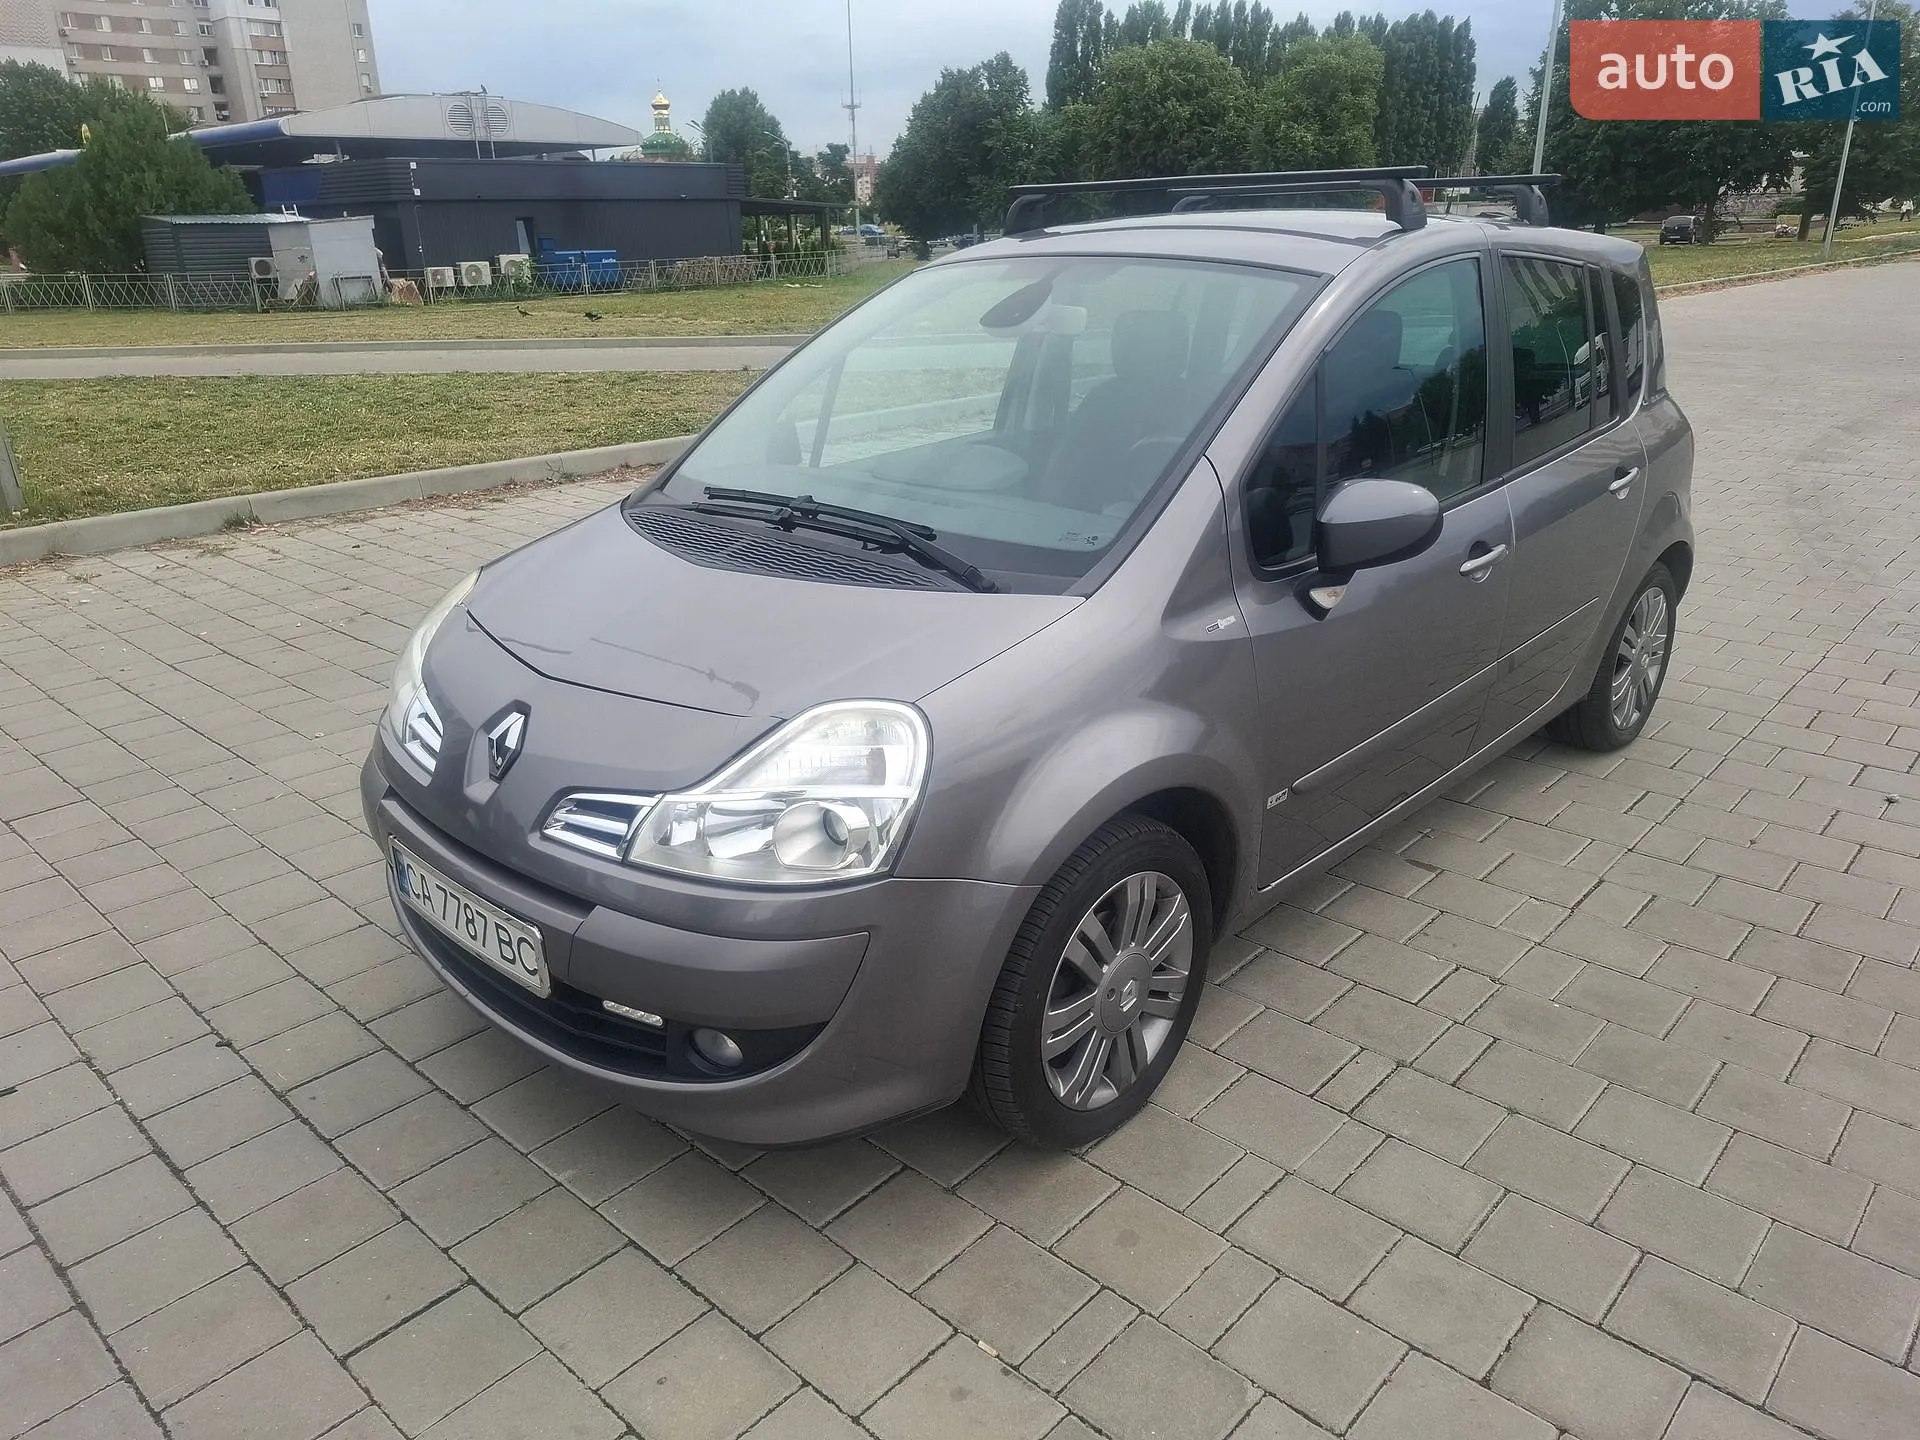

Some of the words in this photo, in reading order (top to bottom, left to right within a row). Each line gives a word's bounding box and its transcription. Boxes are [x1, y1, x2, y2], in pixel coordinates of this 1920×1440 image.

[406, 862, 436, 914] CA
[434, 882, 488, 949] 7787
[494, 921, 539, 977] BC
